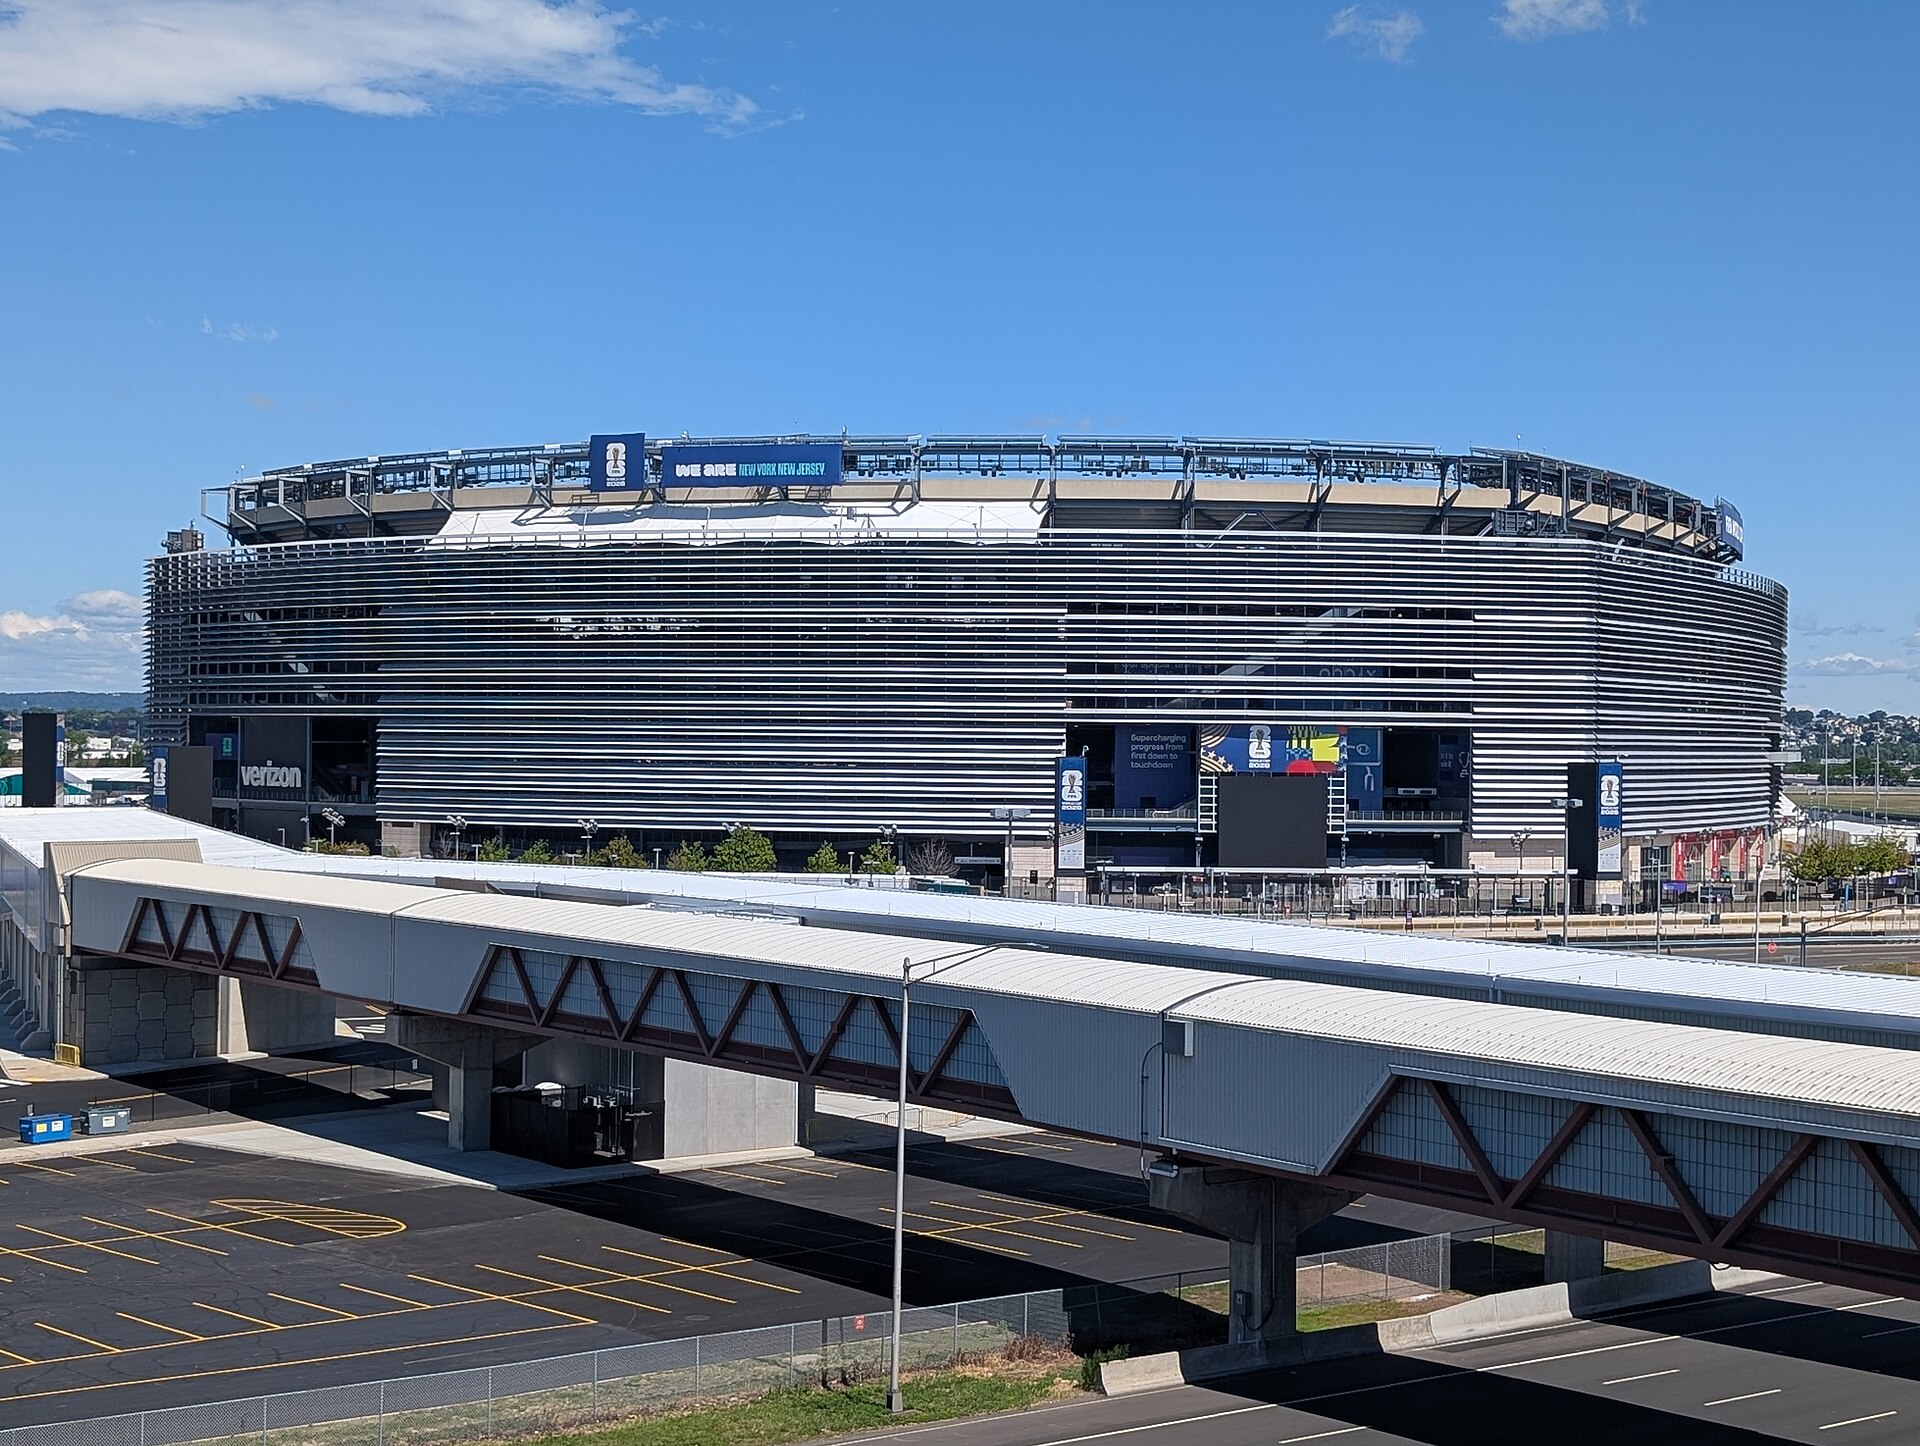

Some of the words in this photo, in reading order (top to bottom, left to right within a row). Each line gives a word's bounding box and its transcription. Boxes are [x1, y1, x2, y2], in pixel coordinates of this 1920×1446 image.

[675, 464, 701, 477] WE
[738, 463, 757, 477] NEW
[757, 463, 776, 476] YORK
[777, 463, 796, 476] NEW
[796, 462, 825, 476] JERSEY
[1130, 733, 1187, 743] Supercharging
[1130, 744, 1164, 752] progress
[1165, 743, 1184, 751] from
[241, 760, 302, 787] verizon
